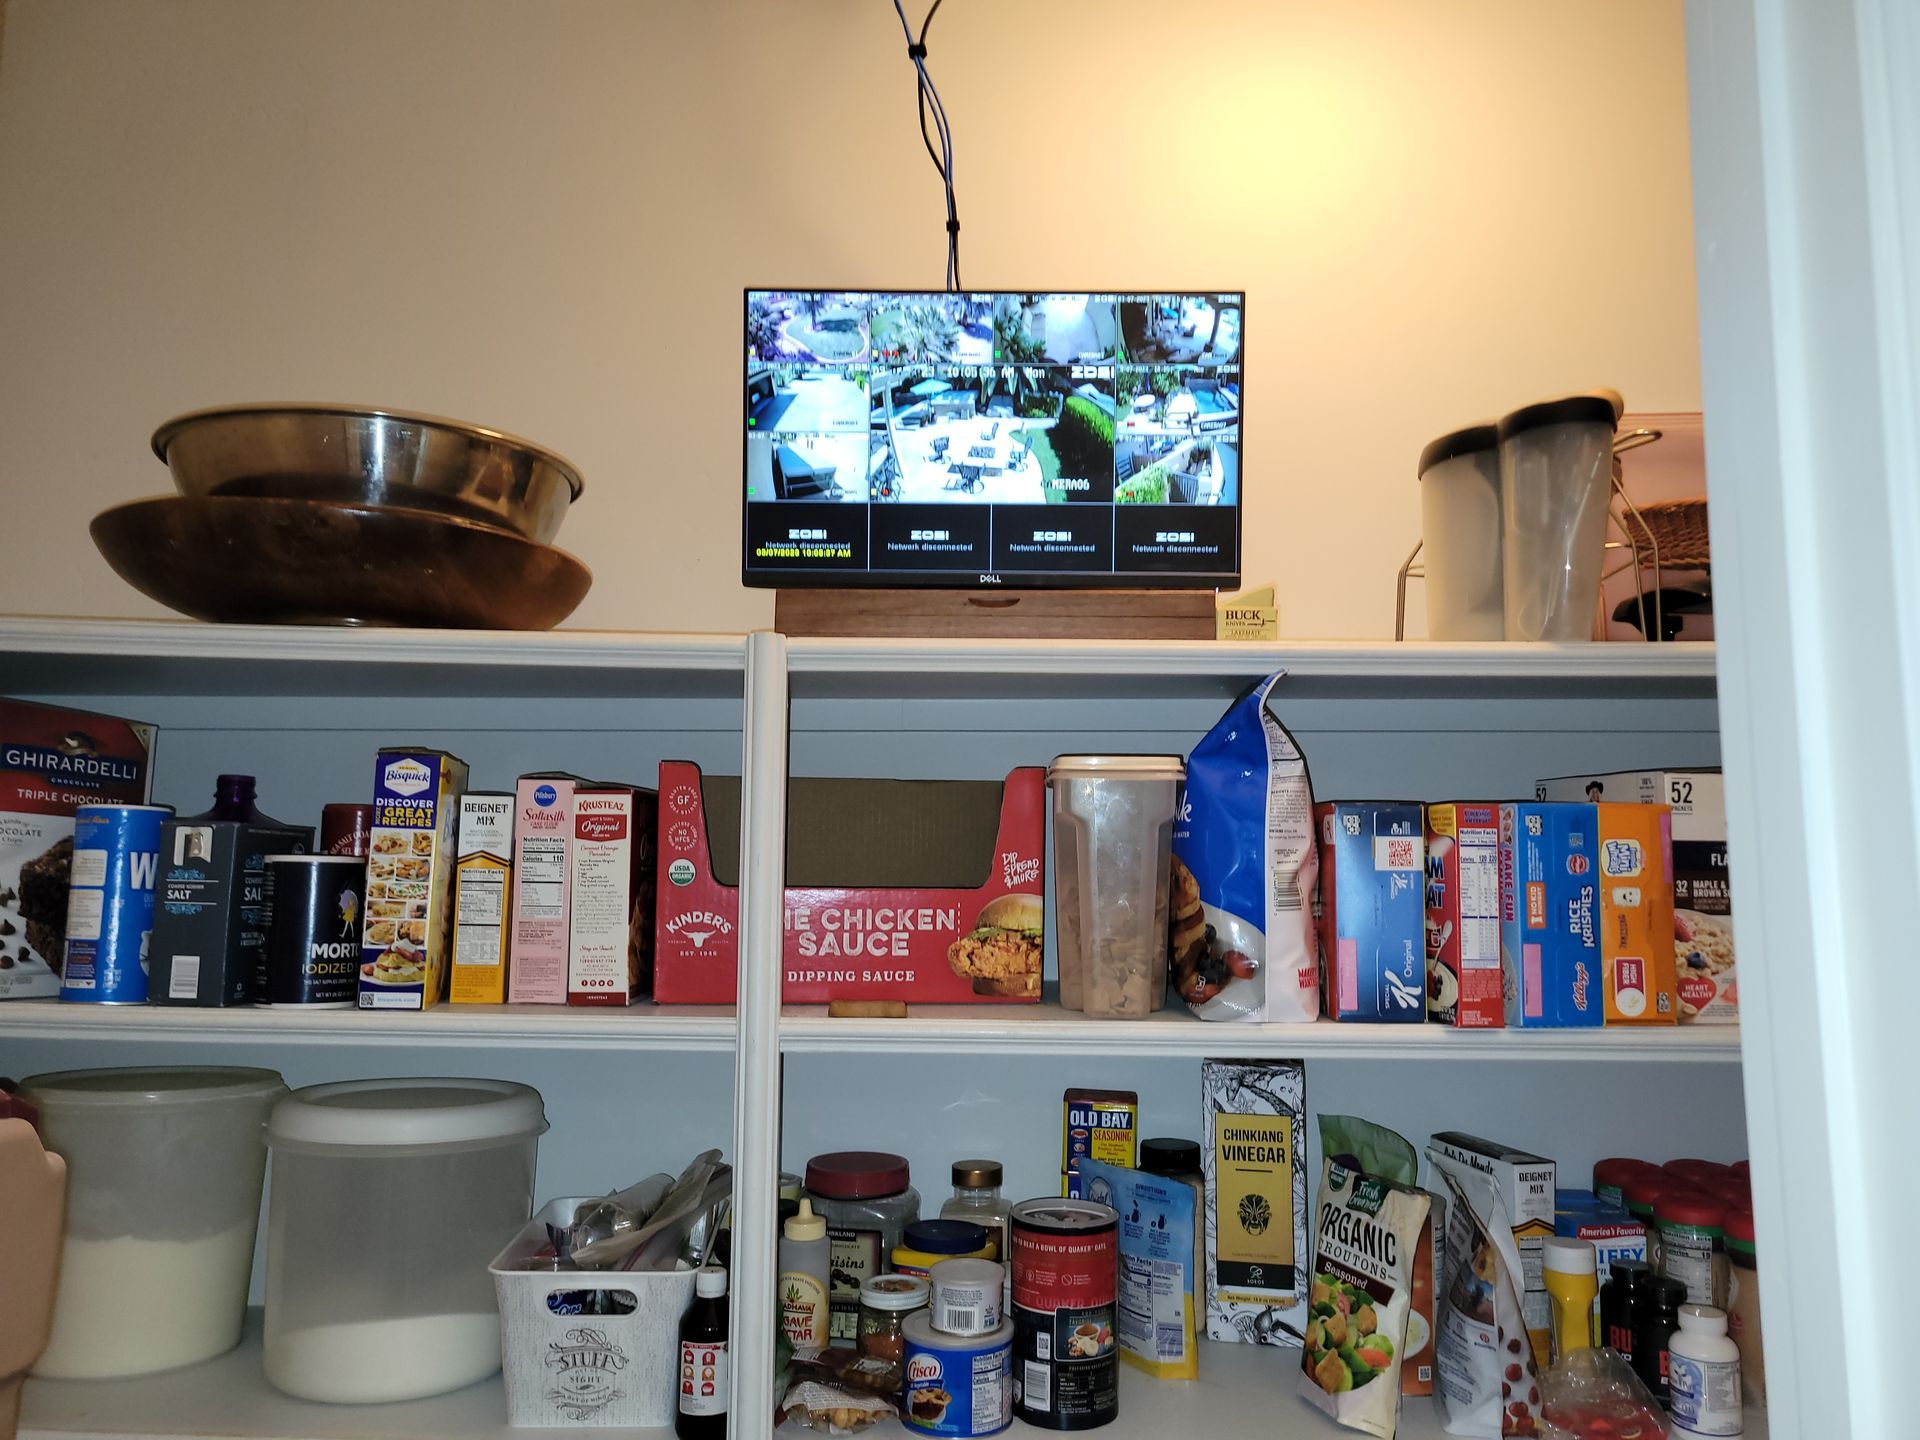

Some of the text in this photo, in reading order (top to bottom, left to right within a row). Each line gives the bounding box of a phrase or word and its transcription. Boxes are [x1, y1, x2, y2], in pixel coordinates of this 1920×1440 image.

[1001, 367, 1014, 378] AM
[1025, 367, 1045, 378] Mon
[1071, 366, 1115, 379] ZOSI
[788, 529, 827, 540] ZOSI
[910, 530, 949, 541] ZOSI
[1033, 531, 1072, 542] ZOSI
[1156, 532, 1195, 543] ZOSI
[765, 541, 851, 549] Network disconnected
[887, 542, 973, 551] Network disconnected
[1010, 543, 1096, 552] Network disconnected
[1132, 544, 1218, 553] Network disconnected
[837, 549, 851, 557] AM
[980, 574, 1001, 583] DELL
[1225, 610, 1261, 620] BUCK
[6, 749, 137, 780] GHIRARDELLI
[51, 777, 100, 788] CHOCOLATE
[386, 769, 429, 783] Bisquick
[17, 788, 58, 802] TRIPLE
[534, 790, 557, 801] Pillsbury
[1535, 787, 1547, 803] 52
[1671, 782, 1693, 804] 52
[376, 797, 434, 809] DISCOVER
[578, 799, 624, 812] KRUSTEAZ
[677, 795, 690, 805] GF
[384, 806, 434, 819] GREAT
[464, 803, 508, 814] BEIGNET
[523, 807, 566, 823] Softasilk
[381, 816, 432, 828] RECIPES
[476, 816, 496, 827] MIX
[581, 820, 621, 834] Original
[553, 854, 565, 862] 110
[1002, 851, 1018, 866] DIP
[1606, 841, 1621, 874] Wheats
[1617, 844, 1632, 872] Mini
[1003, 858, 1040, 876] SPREAD
[671, 872, 693, 880] ORGANIC
[1503, 849, 1514, 921] MAKE FUN
[1675, 880, 1726, 893] 32 MAPLE &
[166, 890, 192, 900] SALT
[1693, 888, 1720, 898] BROWN
[665, 911, 732, 934] KINDER'S
[821, 908, 955, 931] CHICKEN
[1568, 899, 1582, 934] RICE
[1580, 885, 1596, 948] KRISPIES
[798, 931, 910, 956] SAUCE
[301, 963, 354, 975] IODIZED
[1384, 966, 1422, 1009] K
[1403, 939, 1415, 978] Original
[1621, 962, 1630, 985] FIBER
[1629, 963, 1637, 984] HIGH
[787, 970, 915, 983] DIPPING SAUCE
[1572, 961, 1590, 1011] Kellogg's
[1685, 984, 1709, 992] HEART
[1681, 991, 1713, 999] HEALTHY
[1070, 1110, 1130, 1128] OLD BAY
[1093, 1130, 1132, 1142] SEASONING
[1223, 1128, 1284, 1144] CHINKIANG
[1222, 1145, 1286, 1164] VINEGAR
[1519, 1171, 1552, 1182] BEIGNET
[1135, 1183, 1167, 1196] DIRECTIONS
[1358, 1180, 1380, 1200] Fresh
[1529, 1184, 1544, 1194] MIX
[1348, 1190, 1382, 1212] Gourmet
[1320, 1202, 1397, 1267] ORGANIC
[1580, 1226, 1645, 1237] America's Favorite
[1023, 1240, 1035, 1250] BEAT
[1040, 1244, 1057, 1253] BOWL
[1068, 1246, 1092, 1254] QUAKER
[1094, 1243, 1106, 1252] OATS
[1136, 1256, 1152, 1266] Facts
[1324, 1260, 1368, 1290] Seasoned
[560, 1351, 616, 1369] STUFF
[908, 1360, 937, 1380] Crisco
[569, 1375, 602, 1384] SIGHT
